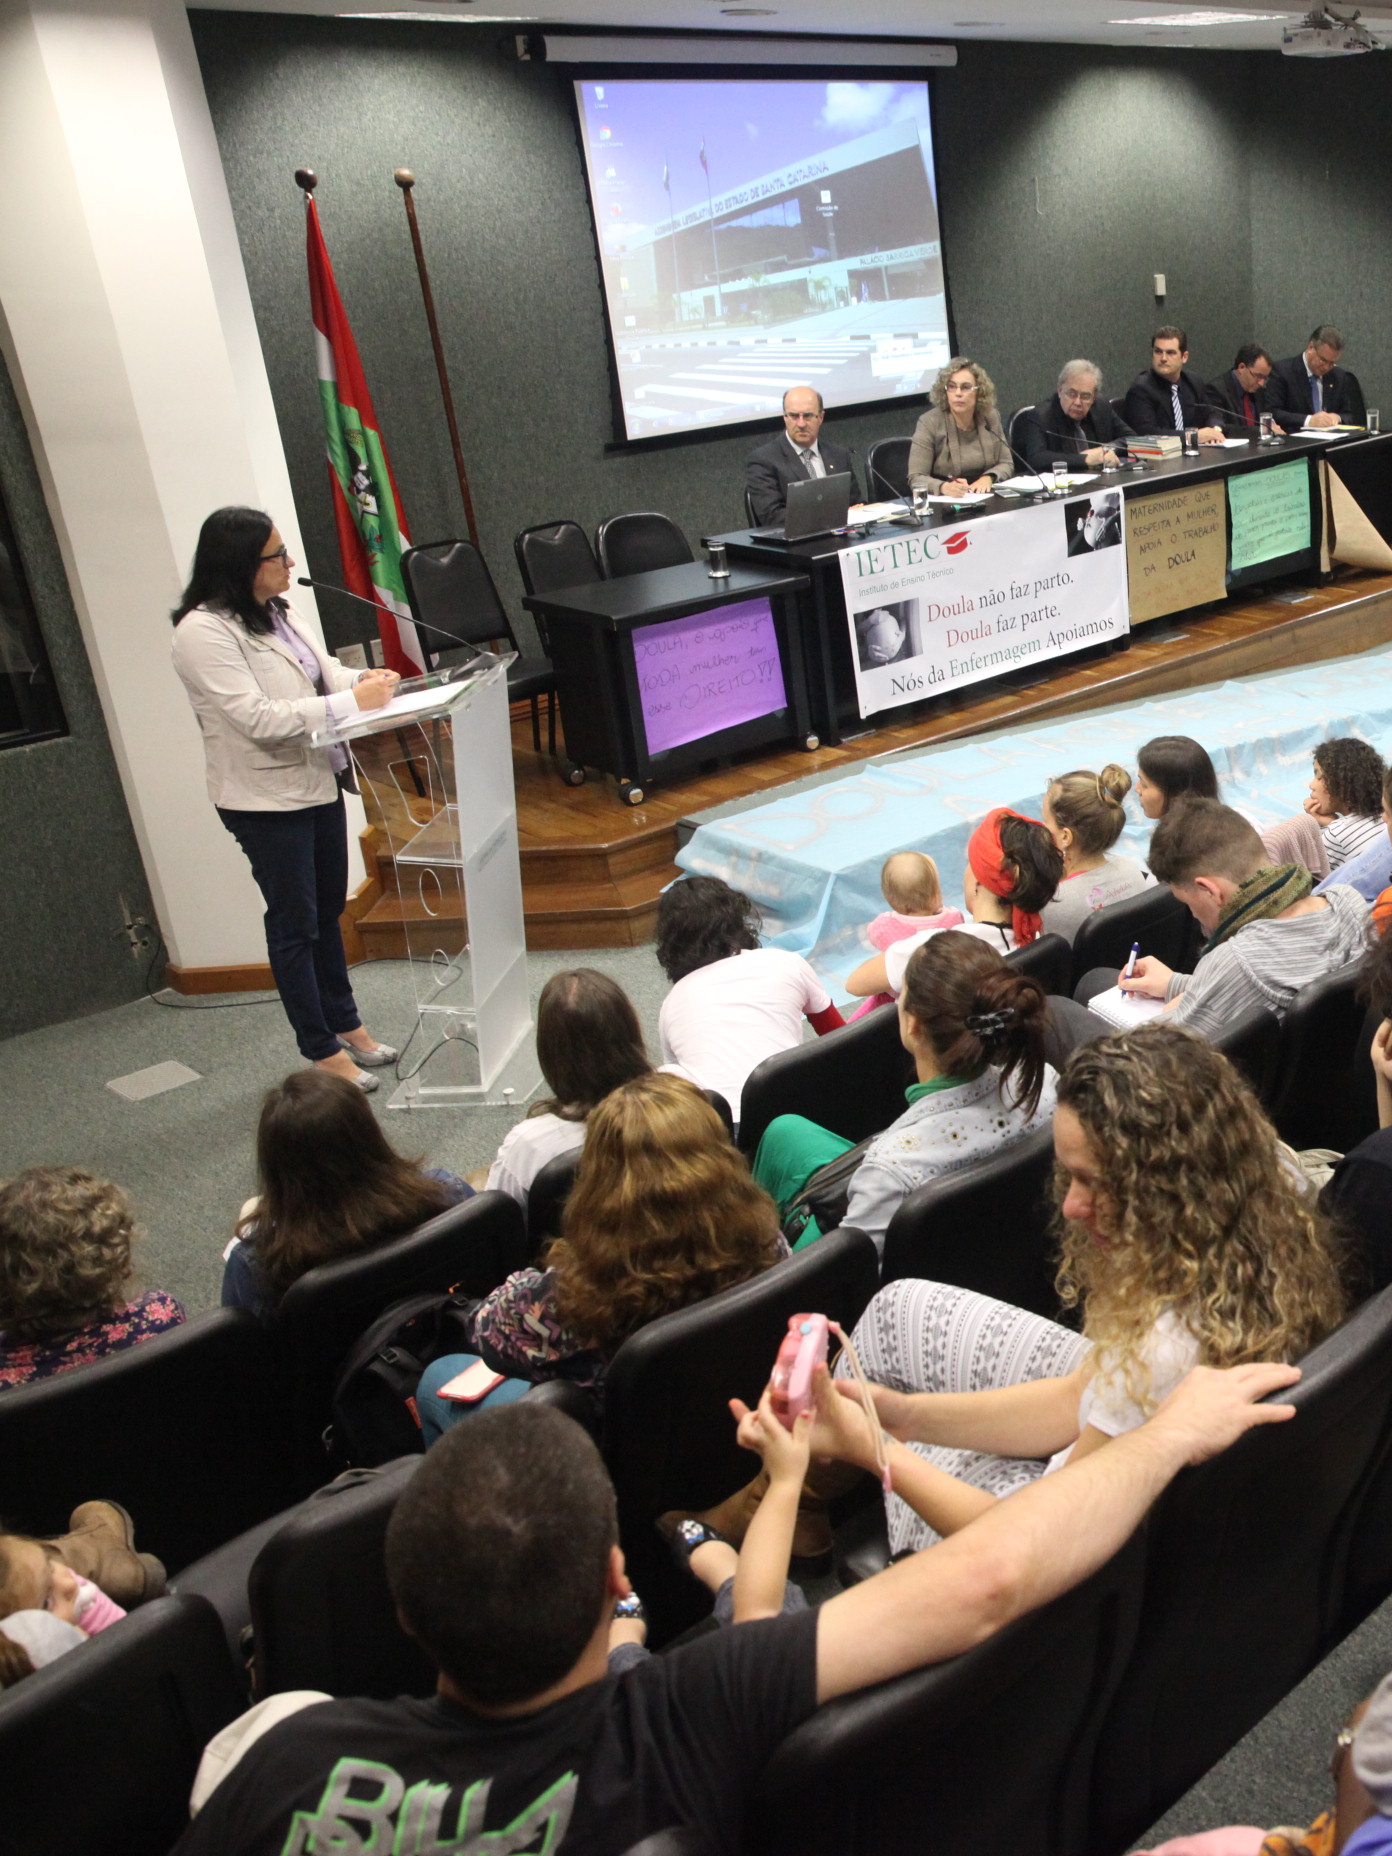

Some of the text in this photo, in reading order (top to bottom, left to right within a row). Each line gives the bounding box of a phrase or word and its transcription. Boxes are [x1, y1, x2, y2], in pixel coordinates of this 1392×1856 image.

[1130, 490, 1210, 520] MATERNIDADE QUE
[1133, 518, 1171, 537] RESPEITA
[1175, 515, 1181, 525] A
[1140, 538, 1162, 556] APOIA
[1170, 533, 1178, 544] O
[1183, 522, 1219, 540] TRABALHO
[855, 533, 941, 577] IETEC
[1143, 549, 1197, 577] DA DOULA
[859, 567, 954, 598] Instituto de Ensino Técnico
[927, 570, 1075, 623] Doula não faz parto.
[946, 603, 1062, 648] Doula faz parte.
[689, 654, 738, 674] mulher
[891, 614, 1115, 696] Nós da Enfermagem Apoiamos
